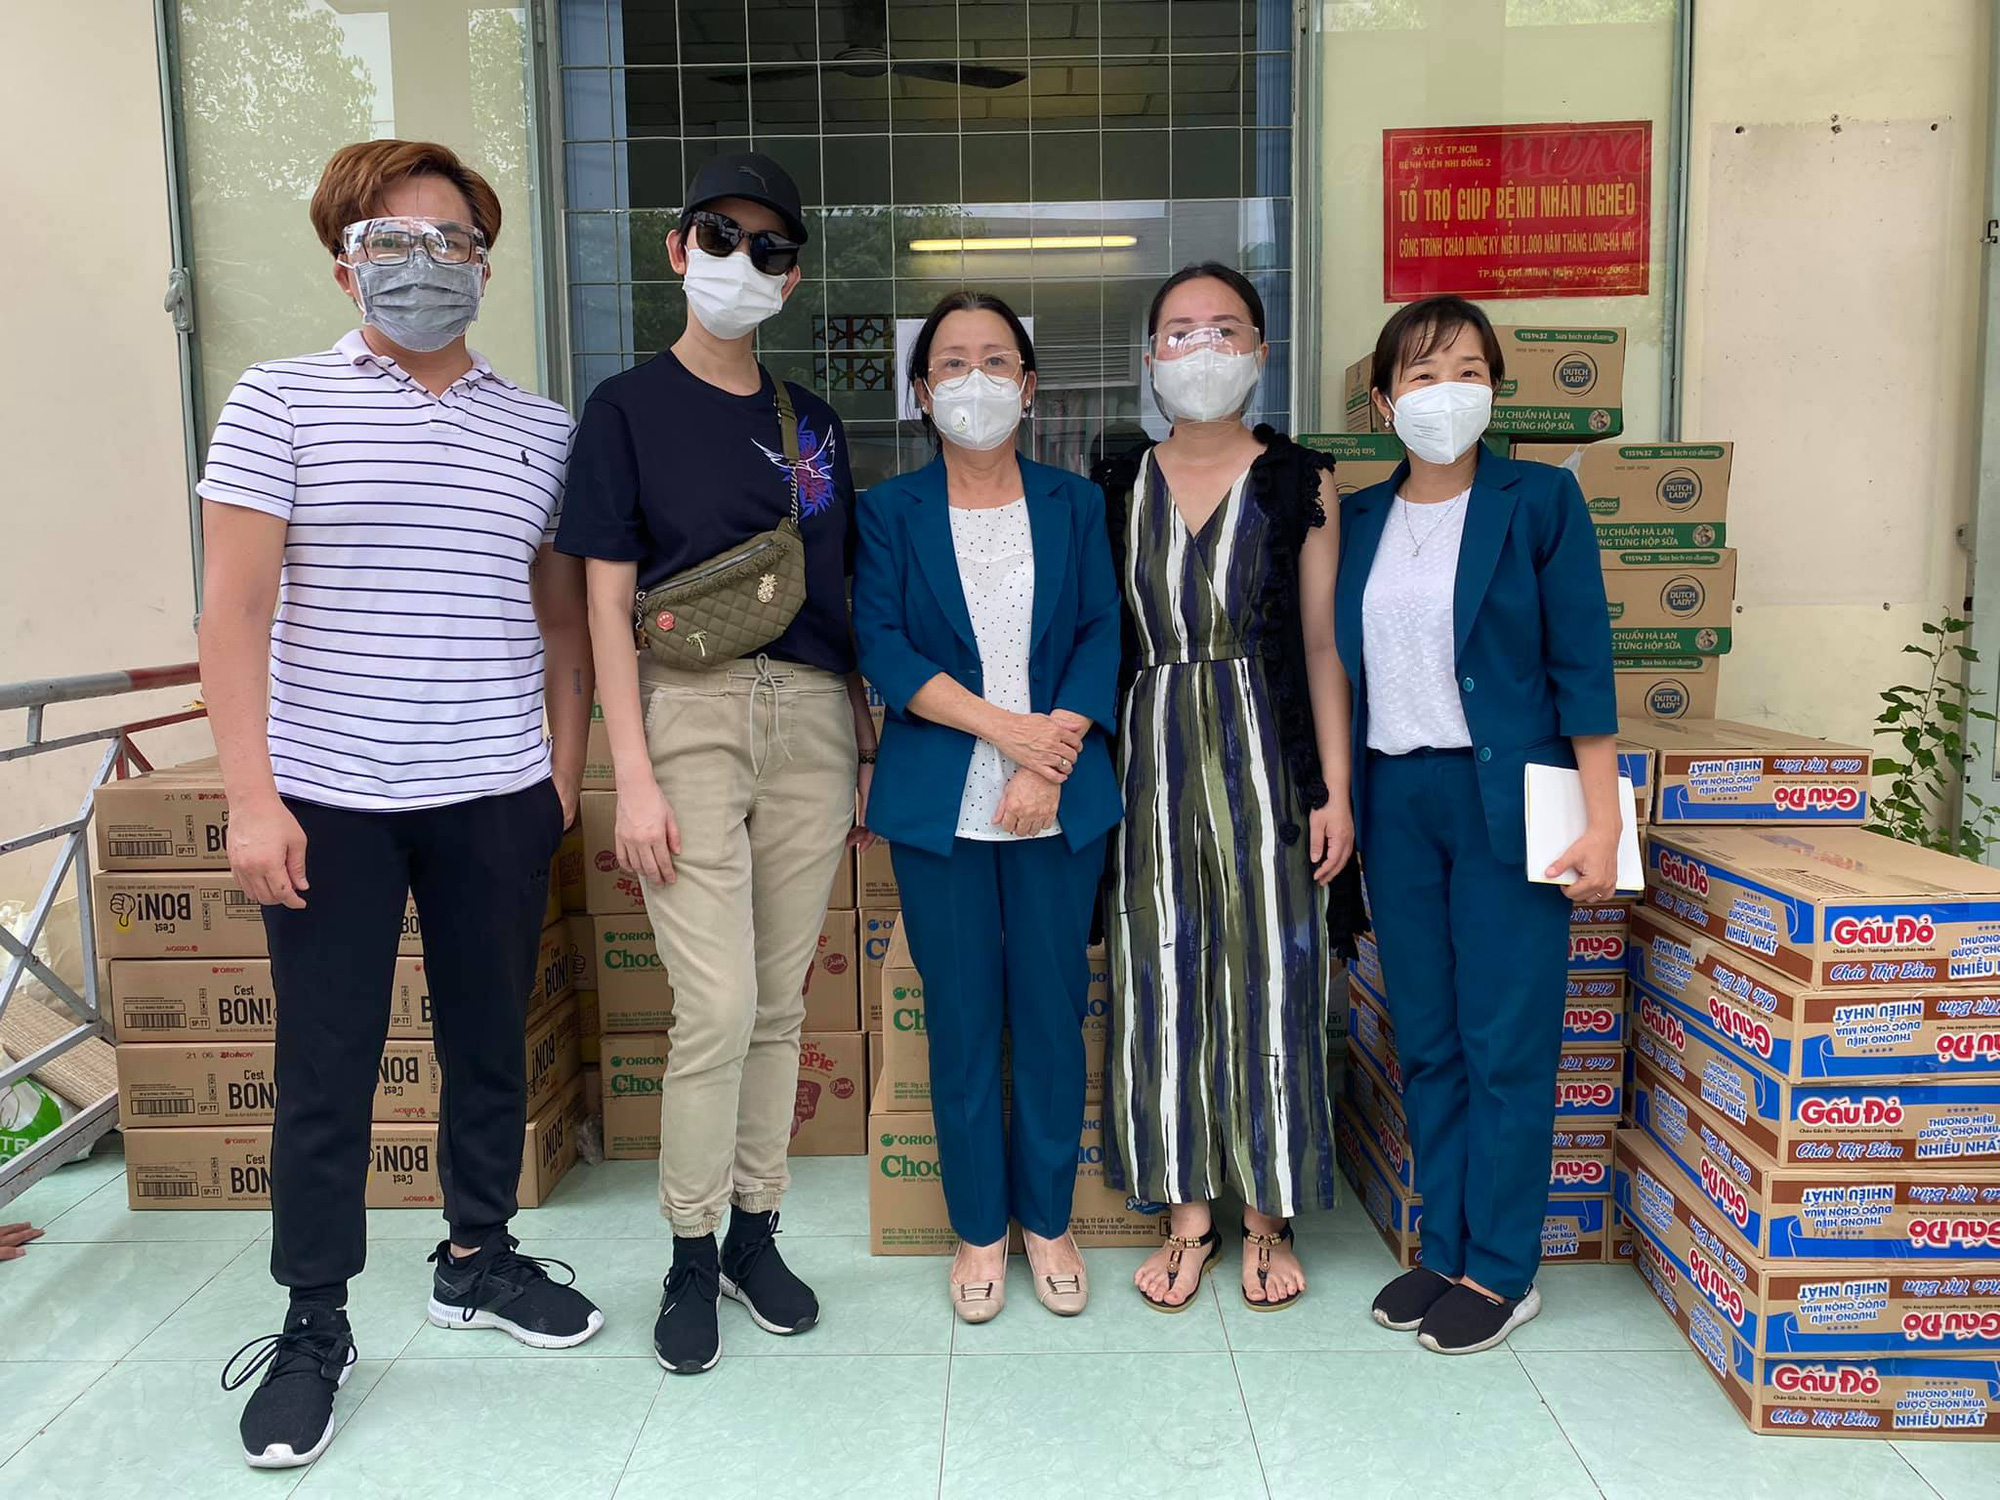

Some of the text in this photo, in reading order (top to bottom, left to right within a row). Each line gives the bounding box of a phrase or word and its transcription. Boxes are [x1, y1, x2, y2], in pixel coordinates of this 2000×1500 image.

[1425, 146, 1431, 155] Y
[1485, 158, 1491, 167] 2
[1399, 175, 1636, 229] TỔ TRỢ GIÚP BỆNH NHÂN NGHÈO
[1399, 233, 1419, 258] CÔNG
[1420, 232, 1443, 257] TRÌNH
[1562, 367, 1589, 376] DUTCH
[1565, 375, 1587, 384] LADY
[1506, 408, 1571, 420] CHUẨN HÀ LAN
[1509, 420, 1575, 432] TỪNG HỘP SỮA
[1666, 484, 1692, 492] DUTCH
[1668, 491, 1690, 499] LADY
[1609, 525, 1674, 536] CHUẨN HÀ LAN
[1614, 537, 1679, 548] TỪNG HỘP SỮA
[1670, 591, 1695, 600] DUTCH
[1613, 630, 1677, 640] CHUẨN HÀ LAN
[1618, 640, 1681, 652] TỪNG HỘP SỮA
[1654, 694, 1680, 703] DUTCH
[1690, 759, 1762, 776] NHIỀU NHẤT
[1774, 787, 1858, 811] Gấu Đỏ
[137, 892, 192, 921] BON!
[155, 922, 175, 934] C'est
[1834, 917, 1935, 945] Gấu Đỏ
[1575, 936, 1623, 960] Gấu
[1951, 946, 1981, 958] ĐƯỢC
[604, 950, 660, 970] Choc
[1831, 961, 1936, 983] Cháo Thịt Bằm
[1950, 959, 1993, 977] NHIỀU
[233, 984, 255, 996] C'est
[218, 998, 272, 1026] BON!
[1836, 1002, 1923, 1026] NHIỀU NHẤT
[1836, 1021, 1922, 1036] ĐƯỢC CHỌN MUA
[1847, 1033, 1911, 1048] THƯƠNG HIỆU
[1936, 1034, 1976, 1061] Đỏ
[626, 1056, 664, 1066] ORION
[243, 1069, 264, 1081] C'est
[611, 1074, 663, 1094] Choc
[228, 1081, 275, 1110] BON
[1564, 1084, 1613, 1106] Gấu
[1801, 1097, 1904, 1125] Gấu Đỏ
[1928, 1114, 1995, 1128] THƯƠNG HIỆU
[1918, 1125, 1982, 1139] ĐƯỢC CHỌN
[1796, 1141, 1903, 1161] Cháo Thịt Bằm
[1917, 1137, 1961, 1157] NHIỀU
[245, 1153, 266, 1166] C'est
[376, 1145, 428, 1172] BON!
[880, 1154, 942, 1178] Choc
[1803, 1186, 1895, 1208] NHIỀU NHẤT
[1803, 1205, 1893, 1218] ĐƯỢC CHỌN MUA
[1815, 1217, 1883, 1229] THƯƠNG HIỆU
[1908, 1220, 1950, 1246] Đỏ
[1546, 1241, 1578, 1255] NHẤT
[1799, 1281, 1888, 1304] NHIỀU NHẤT
[1800, 1300, 1886, 1314] ĐƯỢC CHỌN MUA
[1811, 1310, 1877, 1325] THƯƠNG HIỆU
[1902, 1312, 2000, 1340] Gấu Đỏ
[1774, 1366, 1880, 1394] Gấu Đỏ
[1906, 1389, 1974, 1400] THƯƠNG HIỆU
[1896, 1398, 1985, 1411] ĐƯỢC CHỌN MUA
[1771, 1409, 1881, 1430] Cháo Thịt Bằm
[1895, 1409, 1985, 1427] NHIỀU NHẤT
